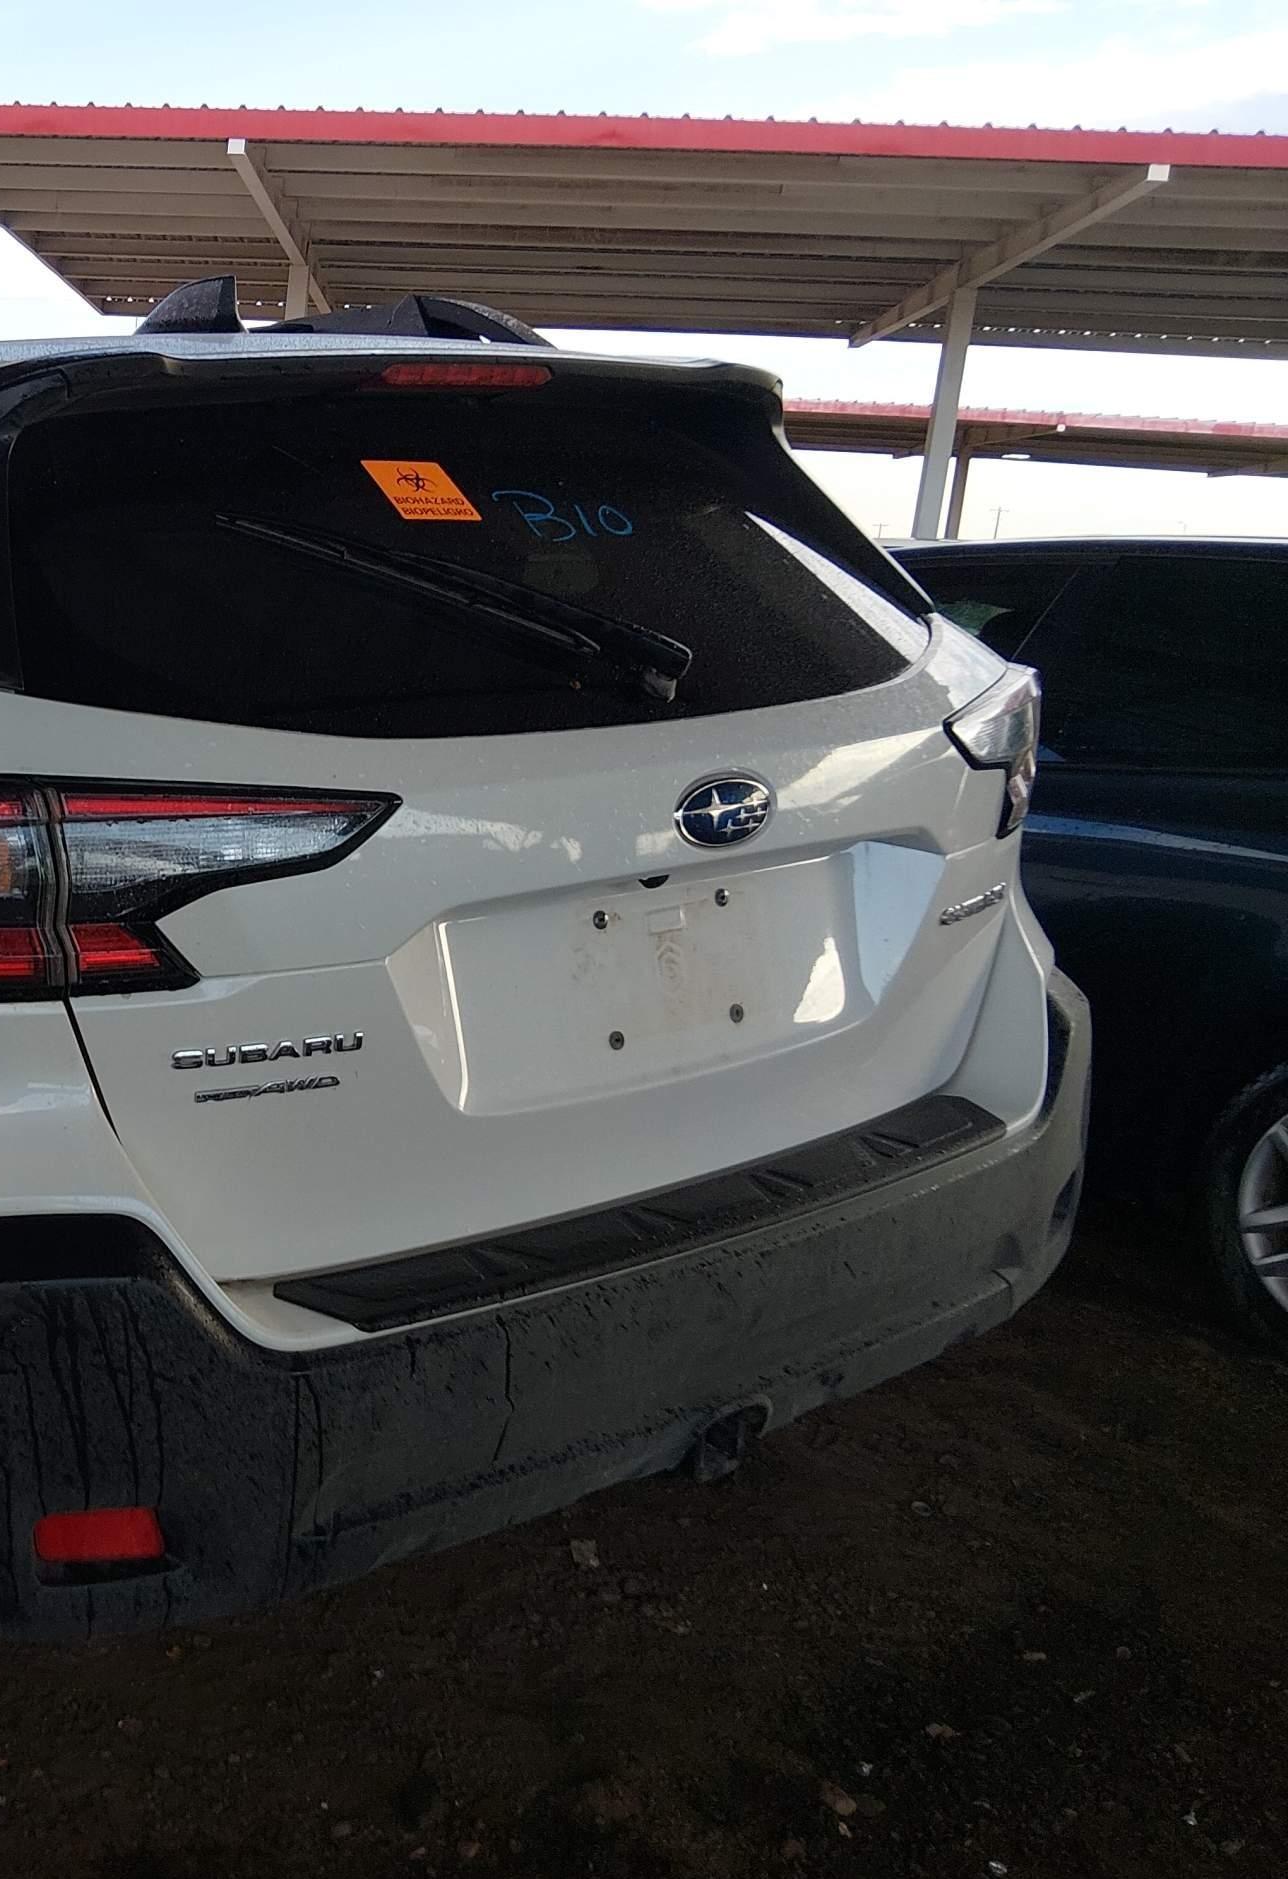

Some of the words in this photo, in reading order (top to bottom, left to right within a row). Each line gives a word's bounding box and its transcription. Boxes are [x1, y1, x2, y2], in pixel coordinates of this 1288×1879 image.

[393, 496, 466, 506] BIOHAZARD
[401, 506, 474, 517] BIOPELIGRO
[171, 1031, 364, 1070] SUBARU
